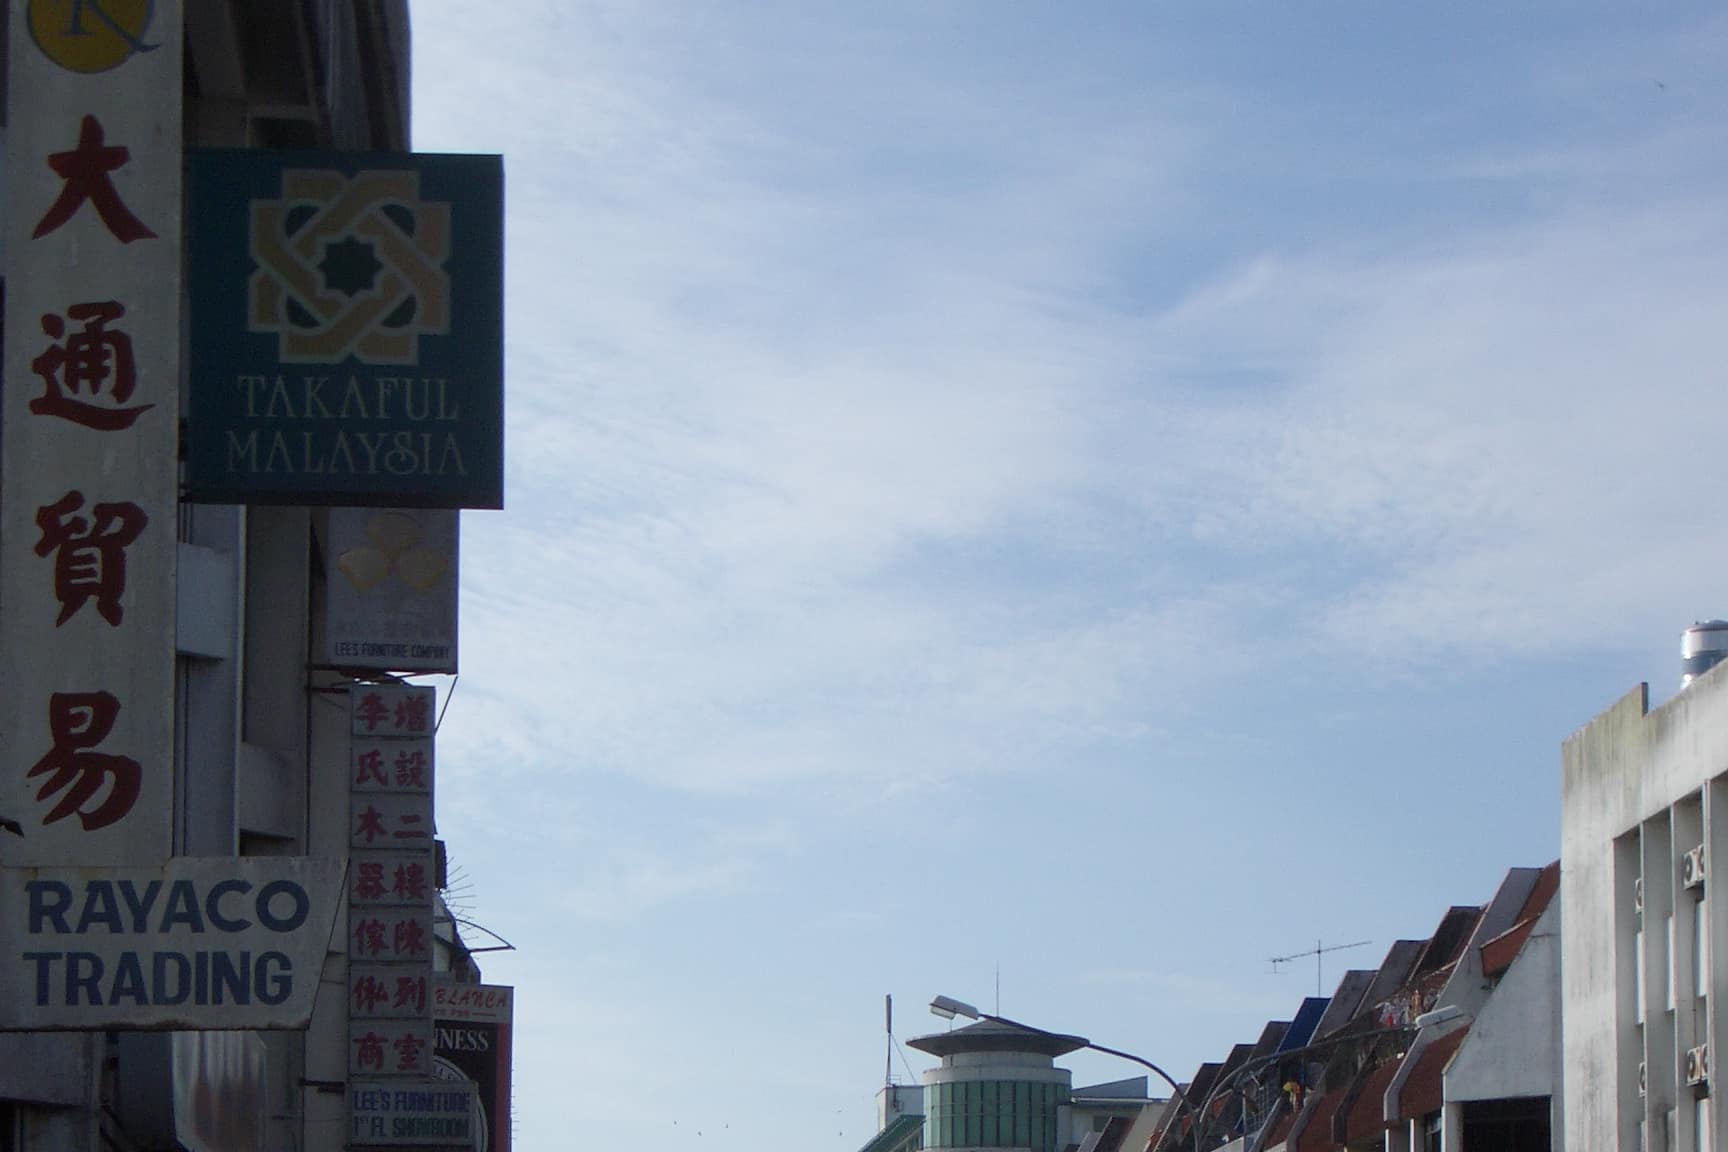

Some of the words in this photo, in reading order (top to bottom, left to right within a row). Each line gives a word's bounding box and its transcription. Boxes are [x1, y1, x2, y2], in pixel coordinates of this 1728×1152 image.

[236, 375, 459, 421] TAKAFUL
[26, 114, 158, 832] 大通貿易
[225, 431, 468, 476] MALAYSIA
[24, 879, 310, 934] RAYACO
[22, 951, 294, 1006] TRADING
